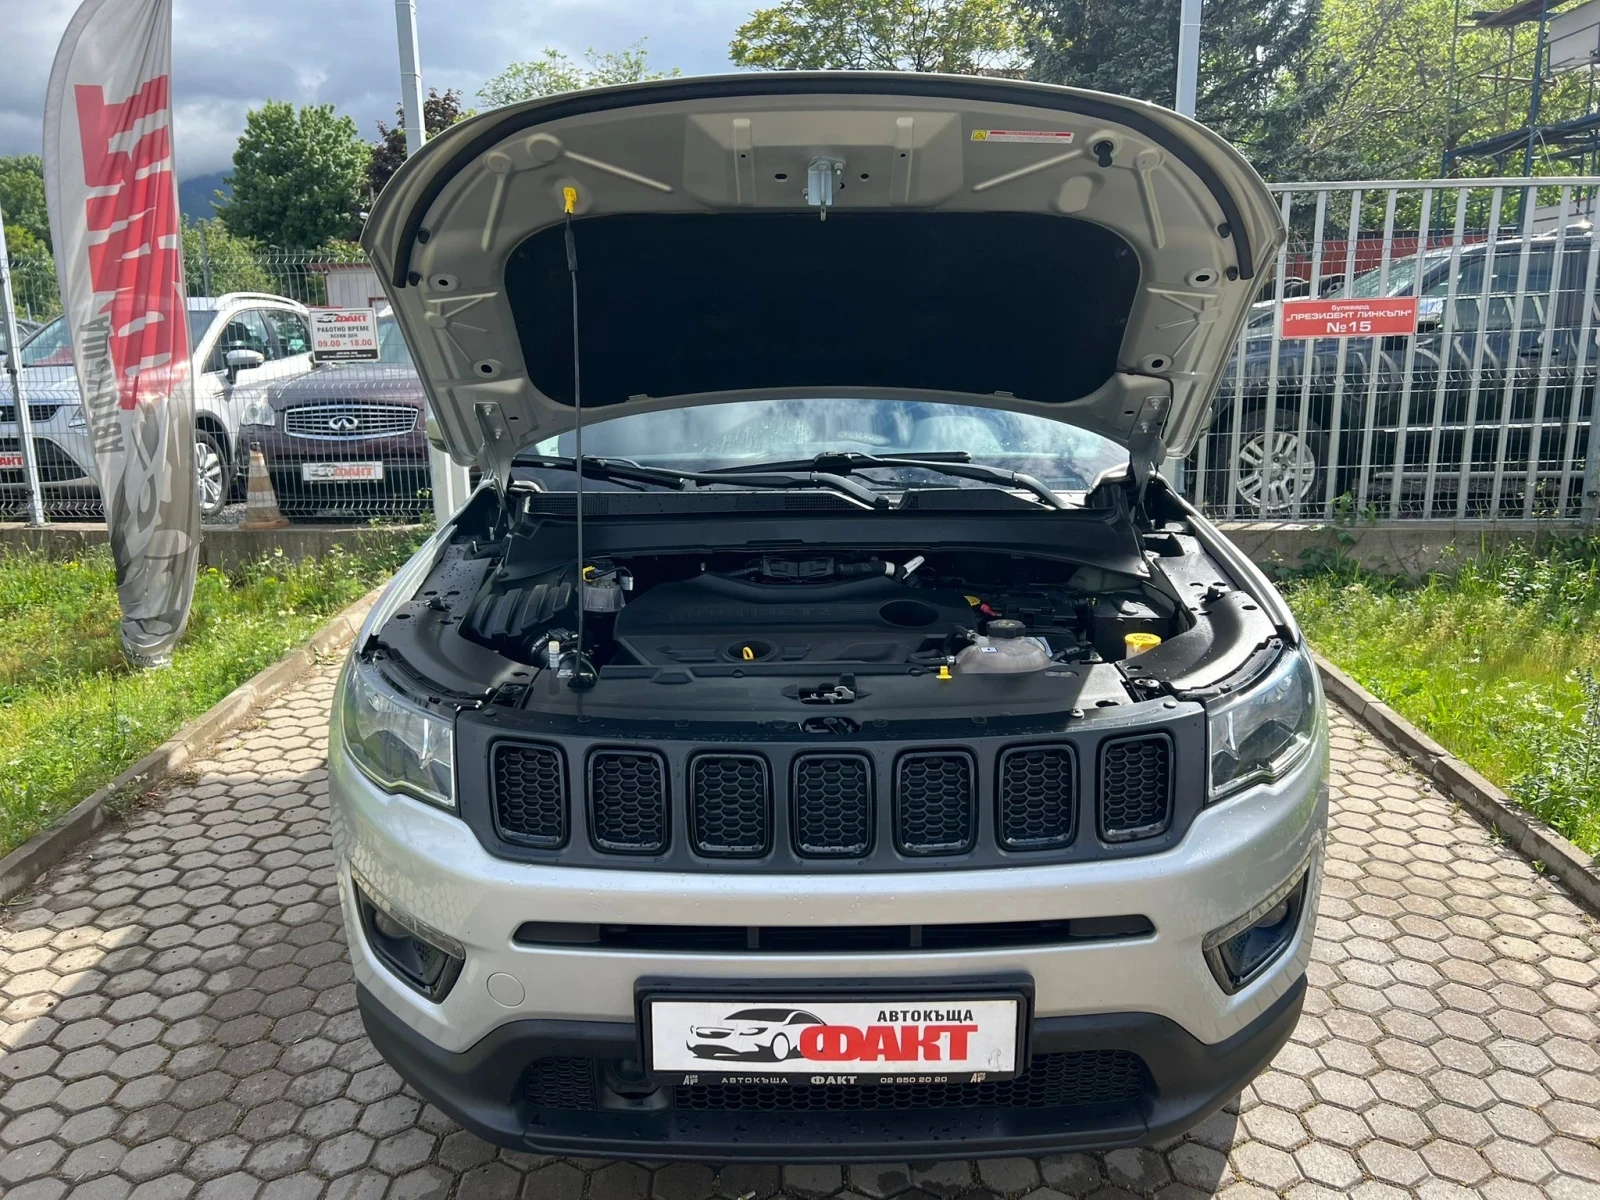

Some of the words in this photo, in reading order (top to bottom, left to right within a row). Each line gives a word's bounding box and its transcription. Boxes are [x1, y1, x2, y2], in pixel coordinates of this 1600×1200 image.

[350, 339, 372, 347] 18.00
[0, 456, 23, 466] АКТ
[877, 1009, 974, 1023] АВТОКЪЩА
[800, 1025, 978, 1061] ФАКТ
[811, 1076, 857, 1085] ФАКТ
